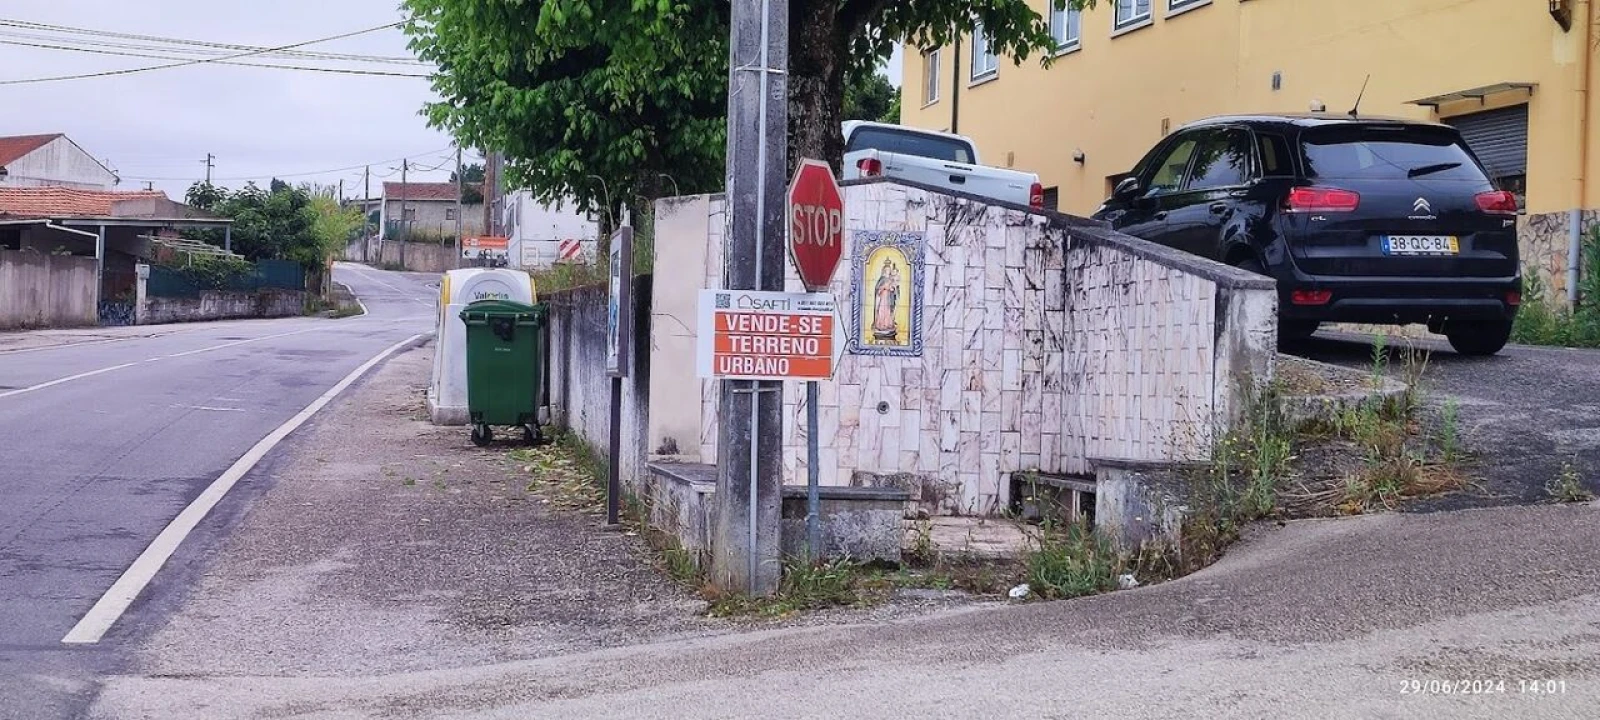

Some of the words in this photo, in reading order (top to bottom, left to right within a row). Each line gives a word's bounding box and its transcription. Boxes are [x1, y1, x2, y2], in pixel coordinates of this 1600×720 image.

[793, 203, 841, 247] STOP
[1390, 237, 1450, 250] 38-QC-84
[725, 314, 823, 334] VENDE-SE
[728, 335, 819, 355] TERRENO
[719, 356, 790, 375] URBANO
